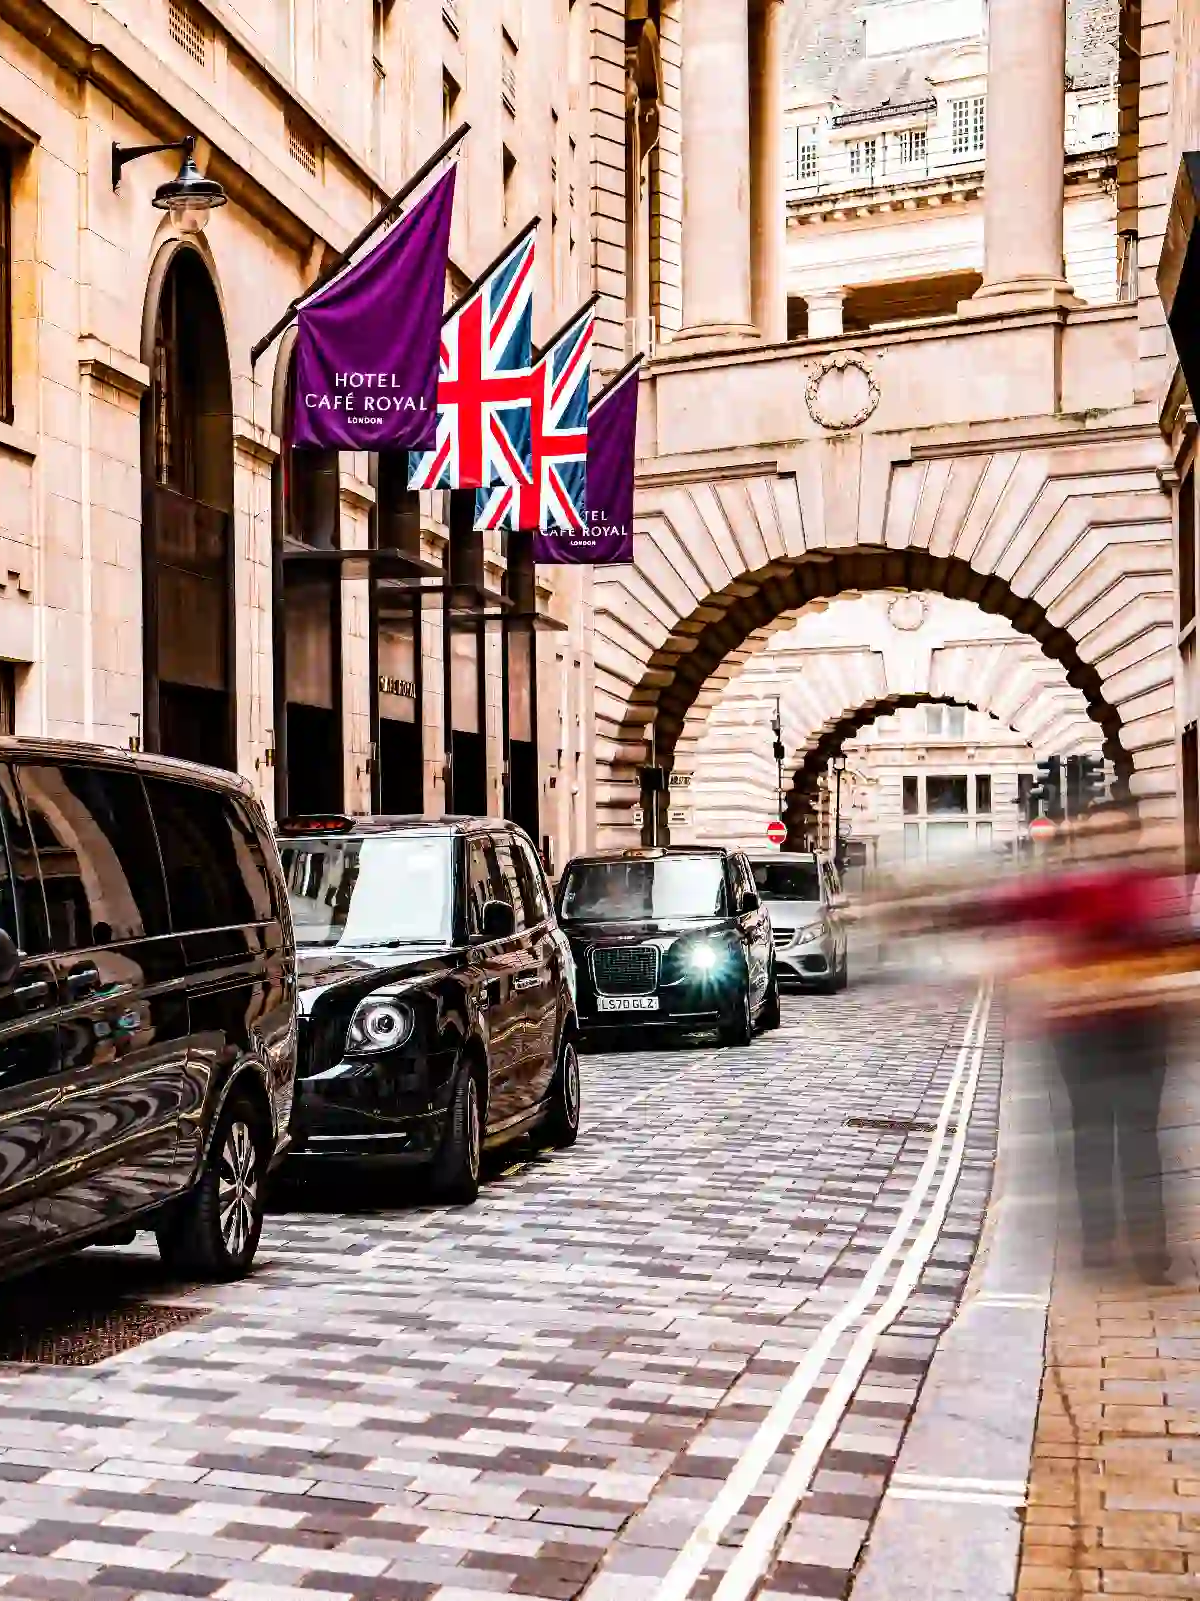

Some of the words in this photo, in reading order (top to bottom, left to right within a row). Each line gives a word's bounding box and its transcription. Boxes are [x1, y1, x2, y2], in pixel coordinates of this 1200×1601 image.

[335, 372, 400, 388] HOTEL
[305, 392, 354, 410] CAFÉ
[364, 396, 428, 411] ROYAL
[347, 416, 383, 424] LONDON
[582, 525, 628, 537] ROYAL
[601, 999, 630, 1010] LS70
